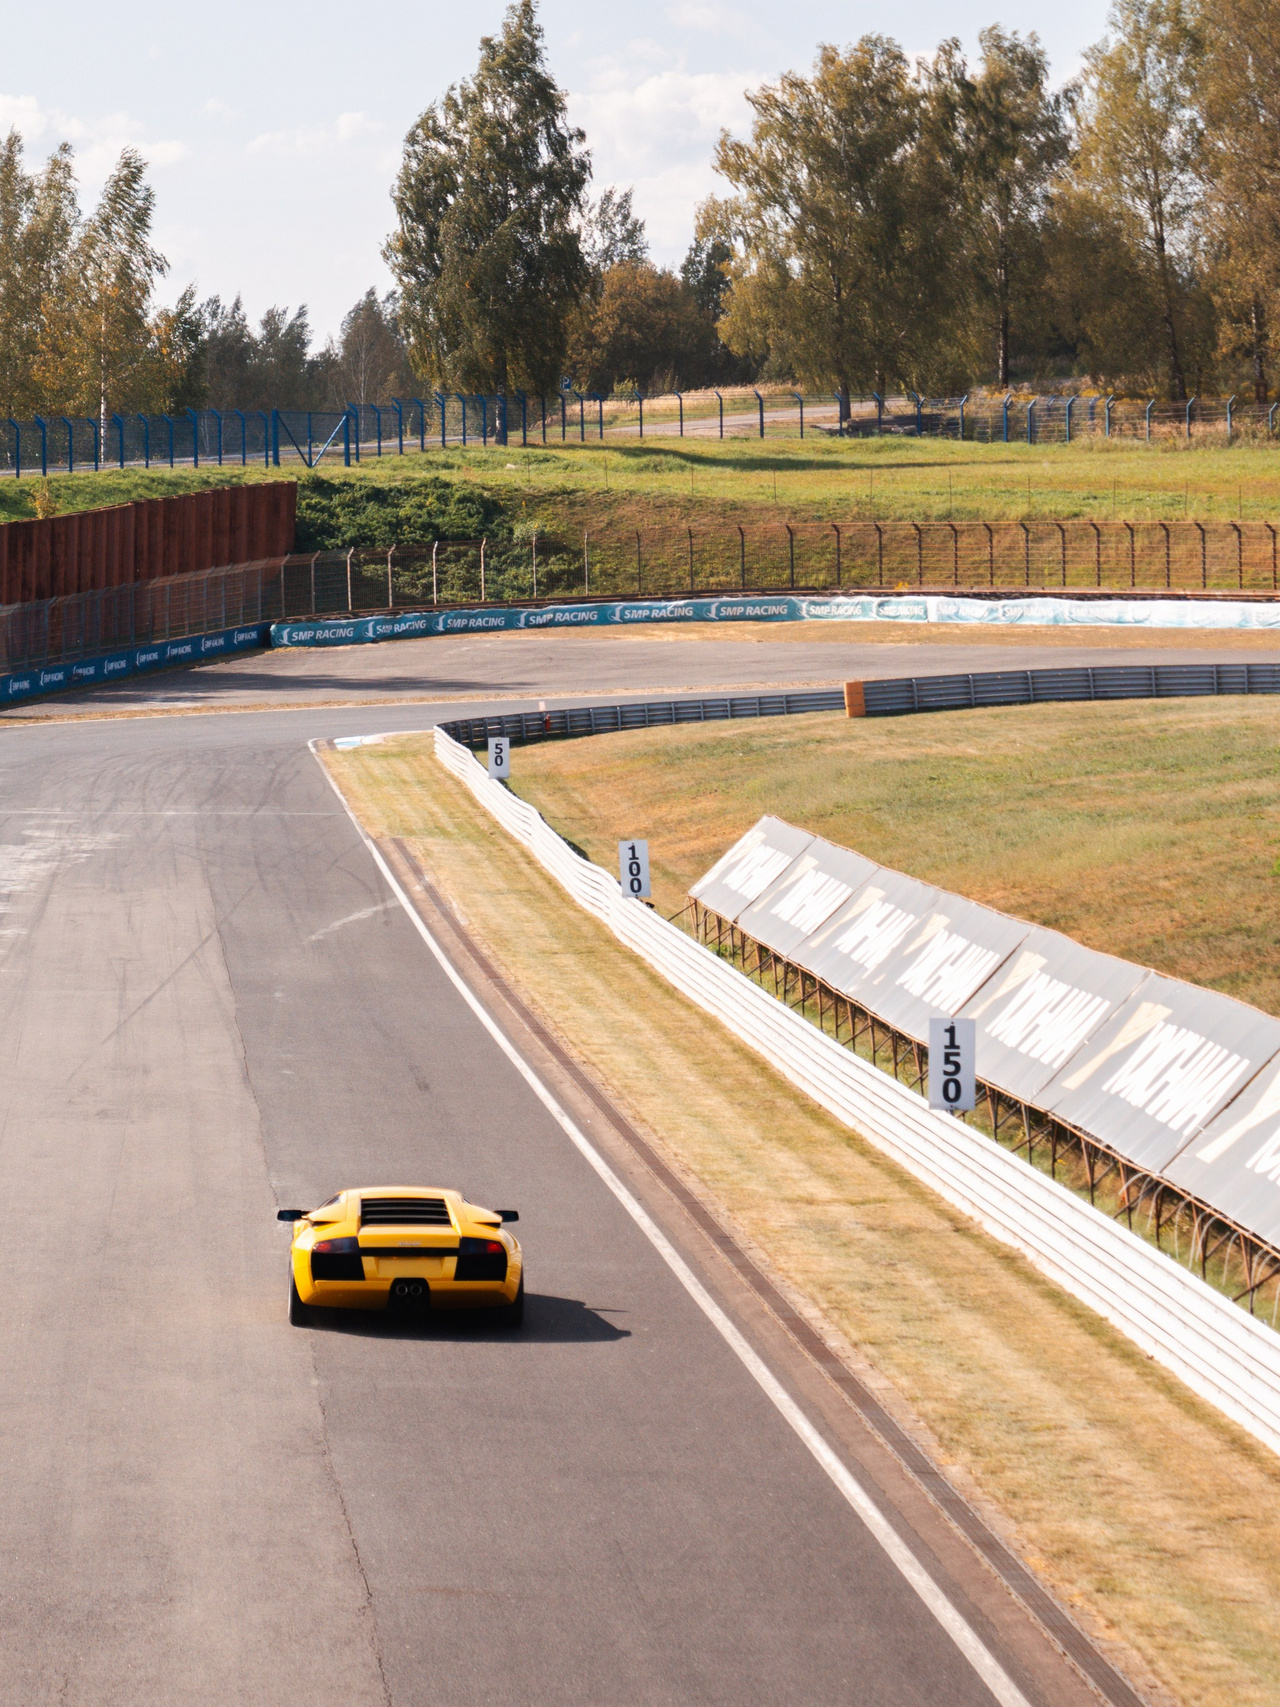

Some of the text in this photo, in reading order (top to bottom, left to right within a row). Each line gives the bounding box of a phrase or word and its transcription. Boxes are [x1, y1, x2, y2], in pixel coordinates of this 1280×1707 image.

[624, 606, 694, 619] SMP RACING
[720, 605, 788, 616] SMP RACING
[809, 605, 862, 616] SMP RACING
[447, 616, 505, 628] SMP RACING
[529, 611, 598, 625] SMP RACING
[394, 620, 427, 633] RACING
[292, 627, 354, 642] SMP RACING
[494, 743, 503, 767] 50
[628, 844, 642, 894] 100
[942, 1025, 962, 1103] 150
[1102, 1021, 1250, 1136] YOKOHAMA
